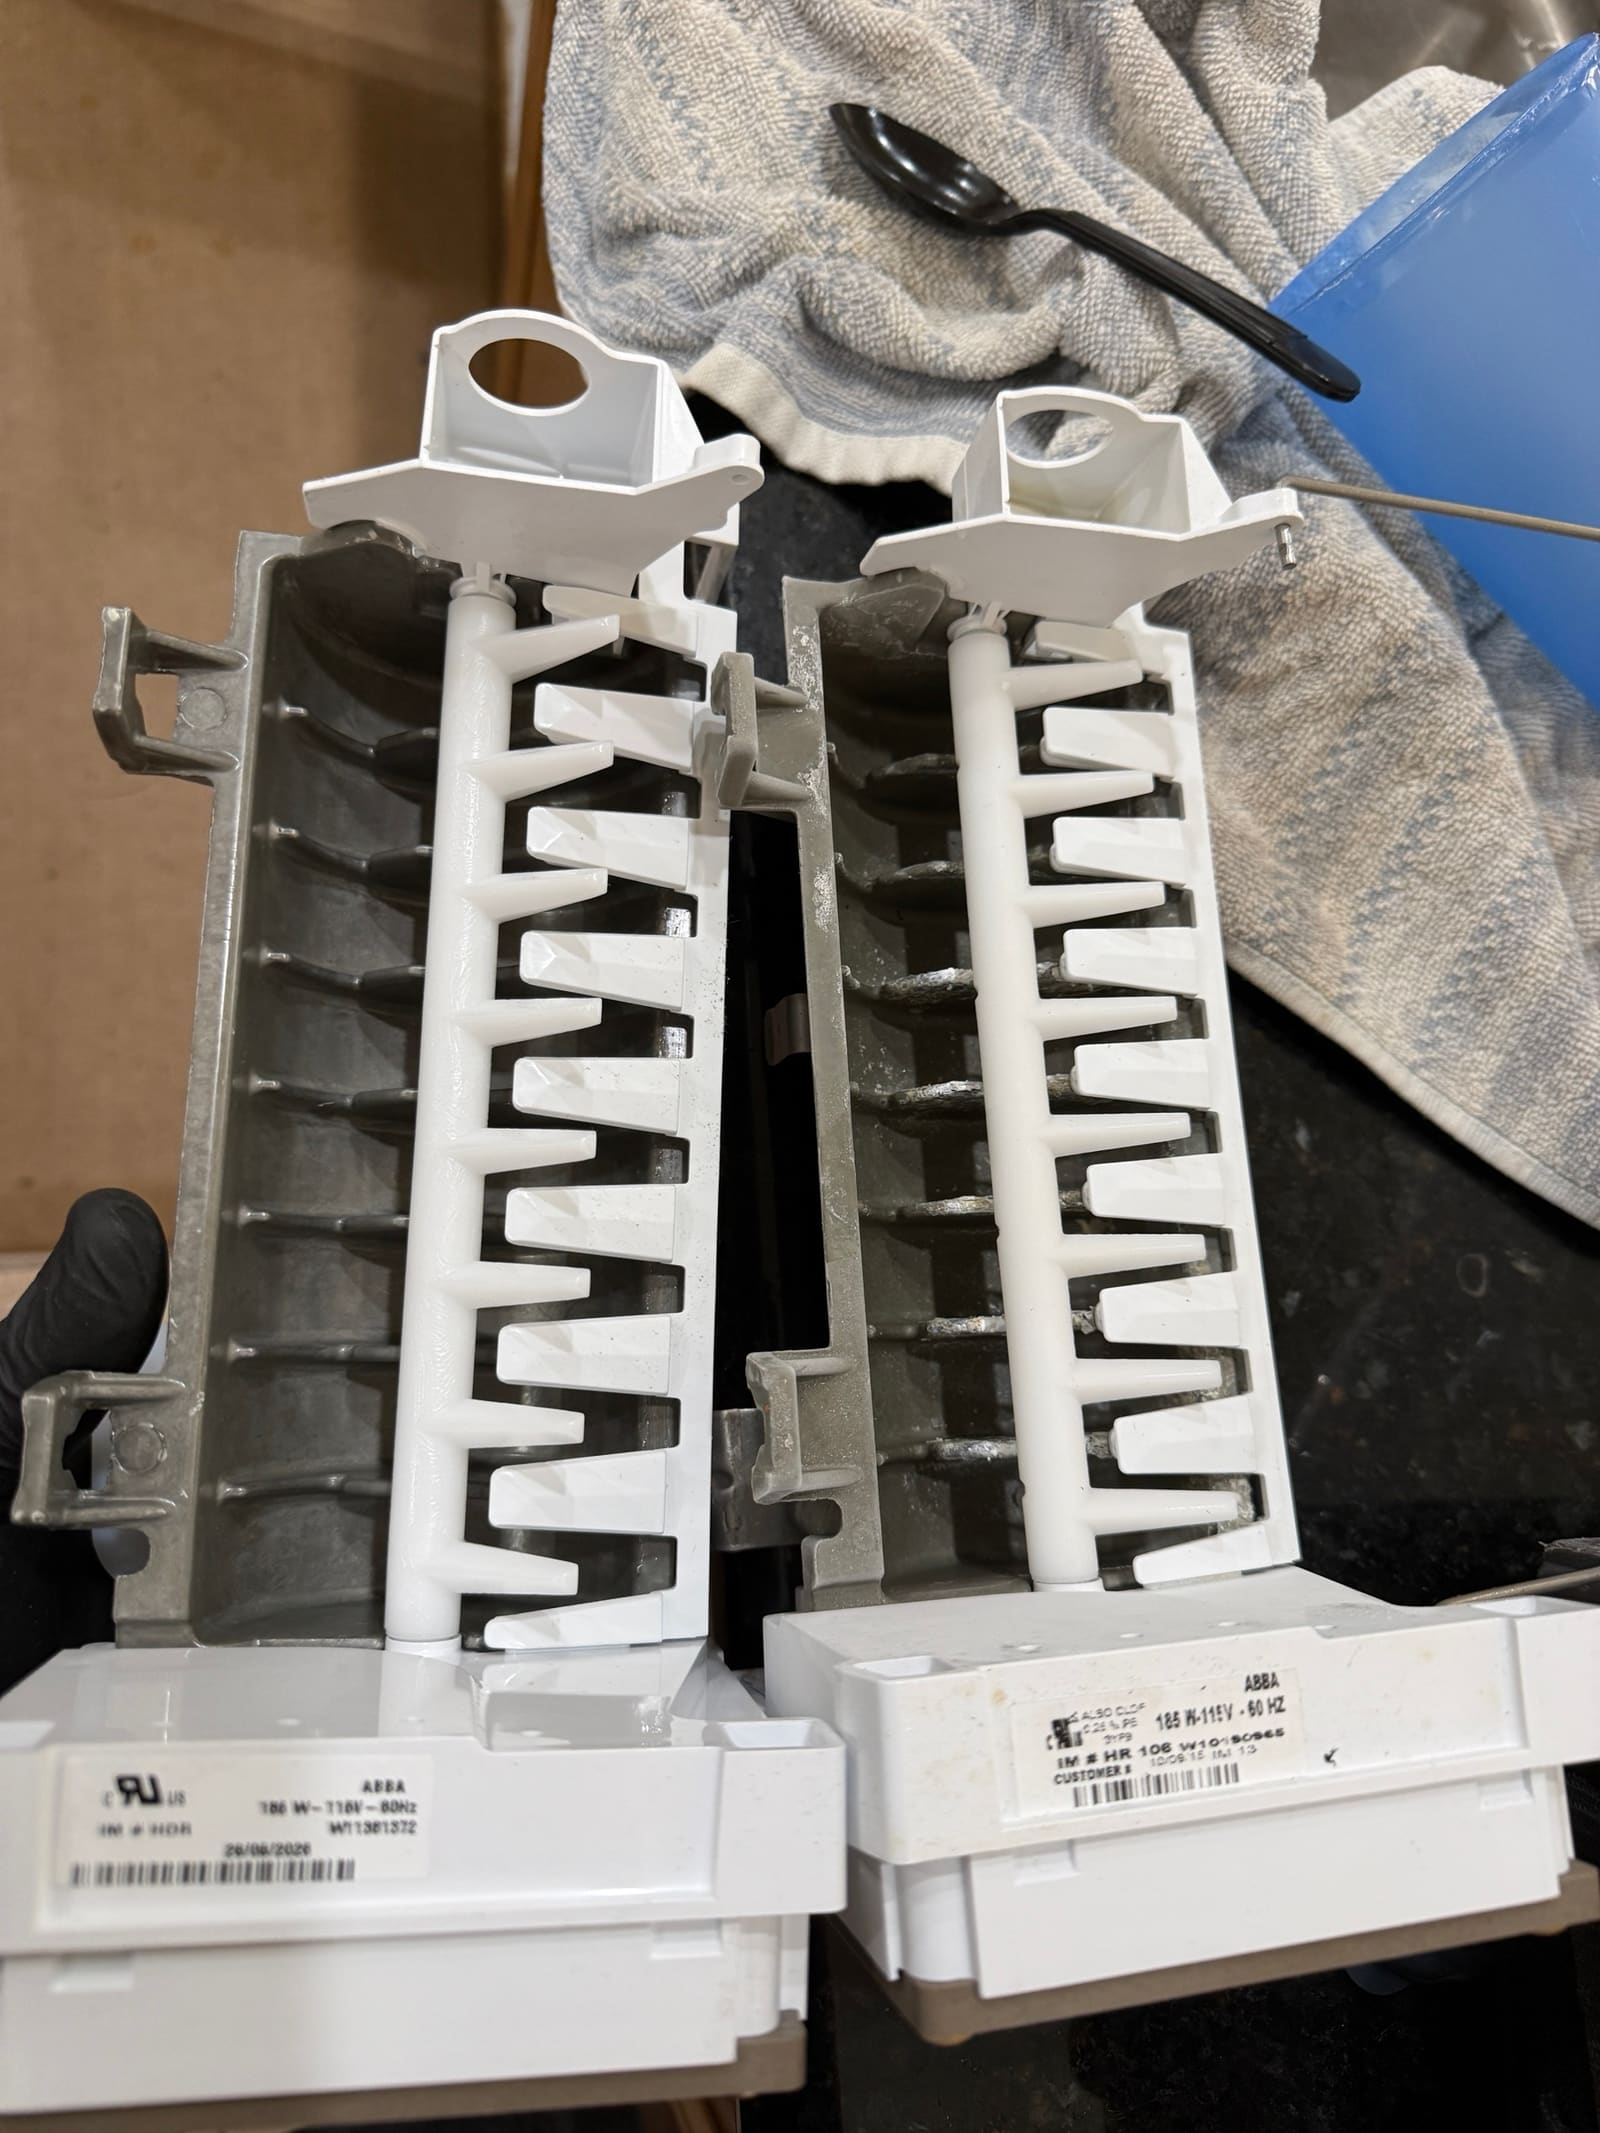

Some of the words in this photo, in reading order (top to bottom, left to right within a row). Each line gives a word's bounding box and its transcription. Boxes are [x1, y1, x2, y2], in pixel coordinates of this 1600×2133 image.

[1244, 1672, 1280, 1692] ABBA
[1156, 1712, 1181, 1732] 185
[1267, 1696, 1287, 1715] HZ
[1105, 1748, 1132, 1761] HR
[1054, 1765, 1121, 1784] CUSTOMER
[362, 1779, 405, 1793] ABBA
